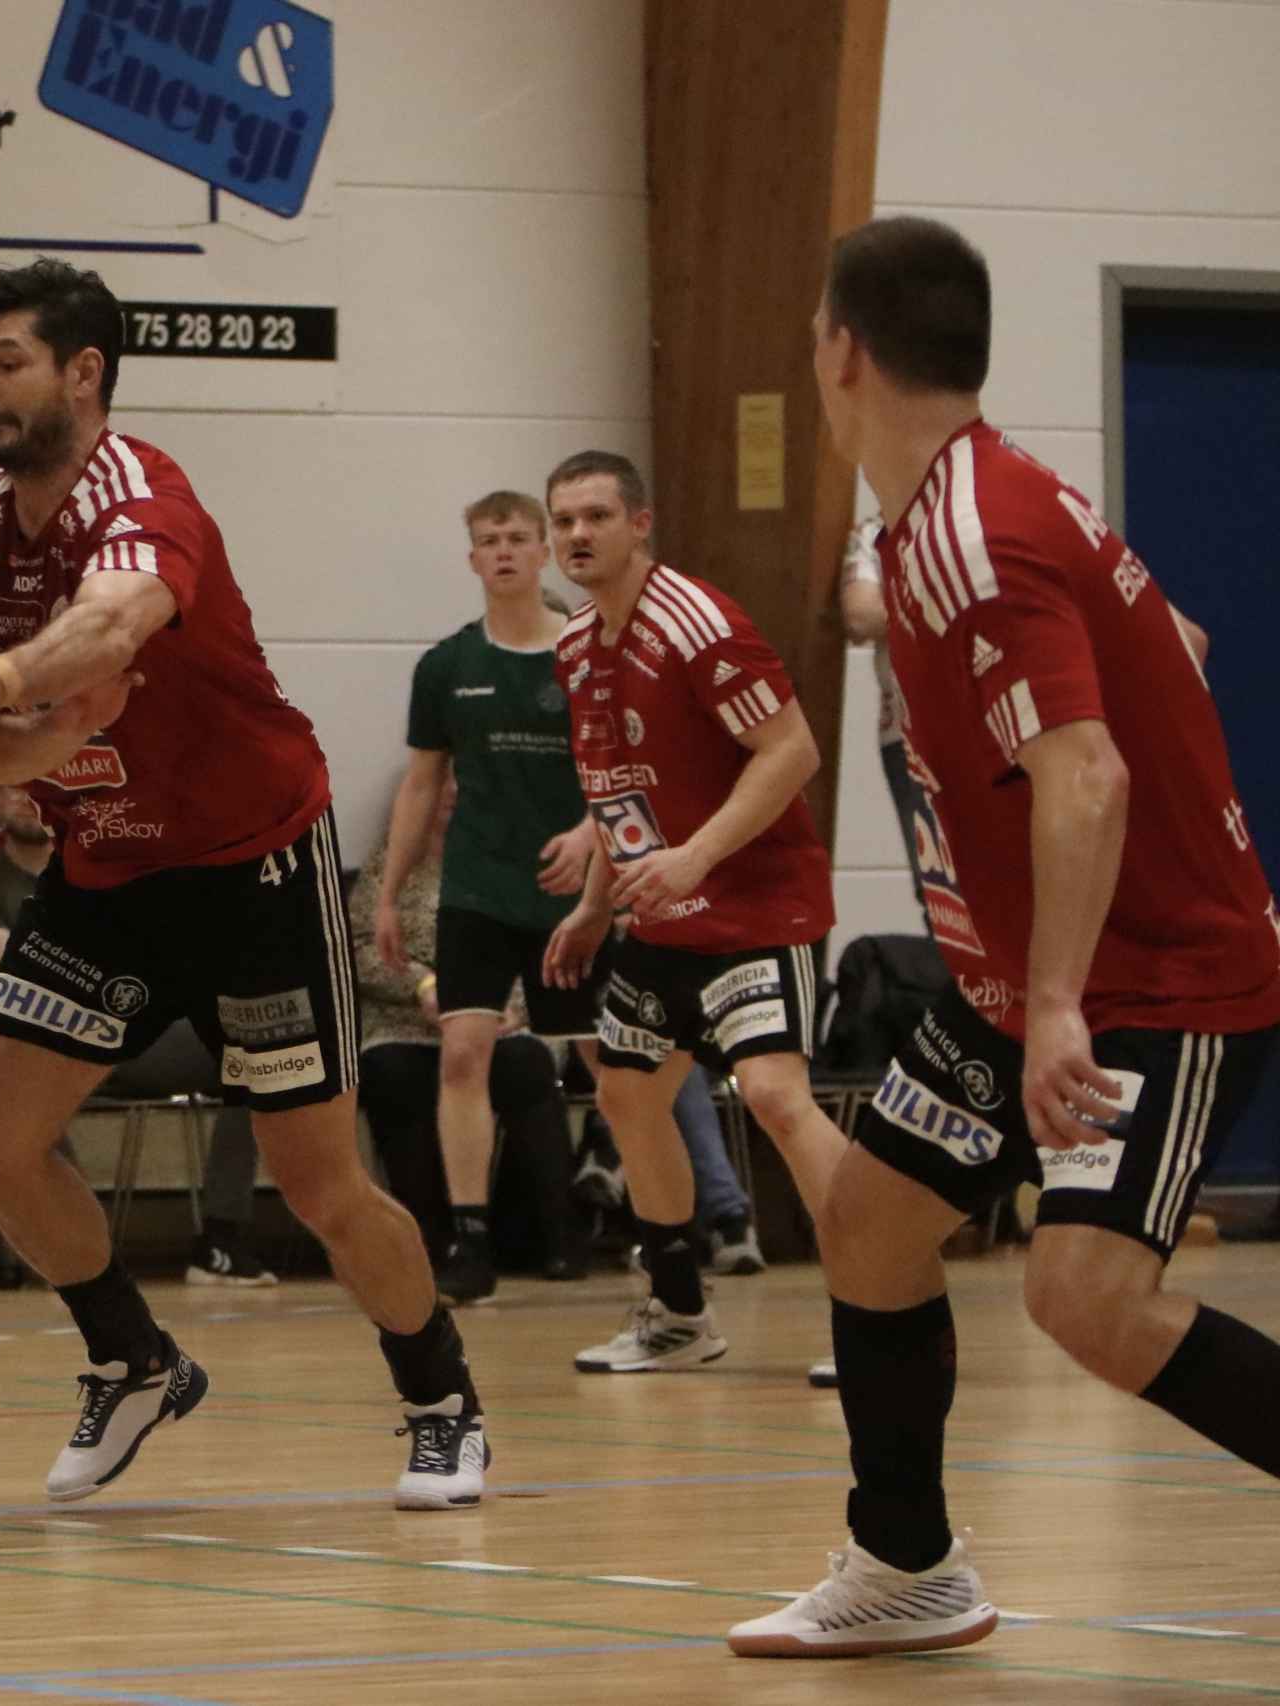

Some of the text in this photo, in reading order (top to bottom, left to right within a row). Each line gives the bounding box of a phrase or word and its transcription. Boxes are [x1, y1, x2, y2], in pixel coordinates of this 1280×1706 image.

[237, 21, 294, 99] &
[64, 12, 309, 184] Energi
[133, 312, 169, 347] 75
[177, 313, 212, 348] 28
[219, 314, 255, 349] 20
[261, 315, 296, 351] 23
[59, 758, 114, 778] MARK
[19, 941, 96, 994] Kommune
[26, 930, 104, 983] Fredericia
[601, 1017, 671, 1059] HILIPS
